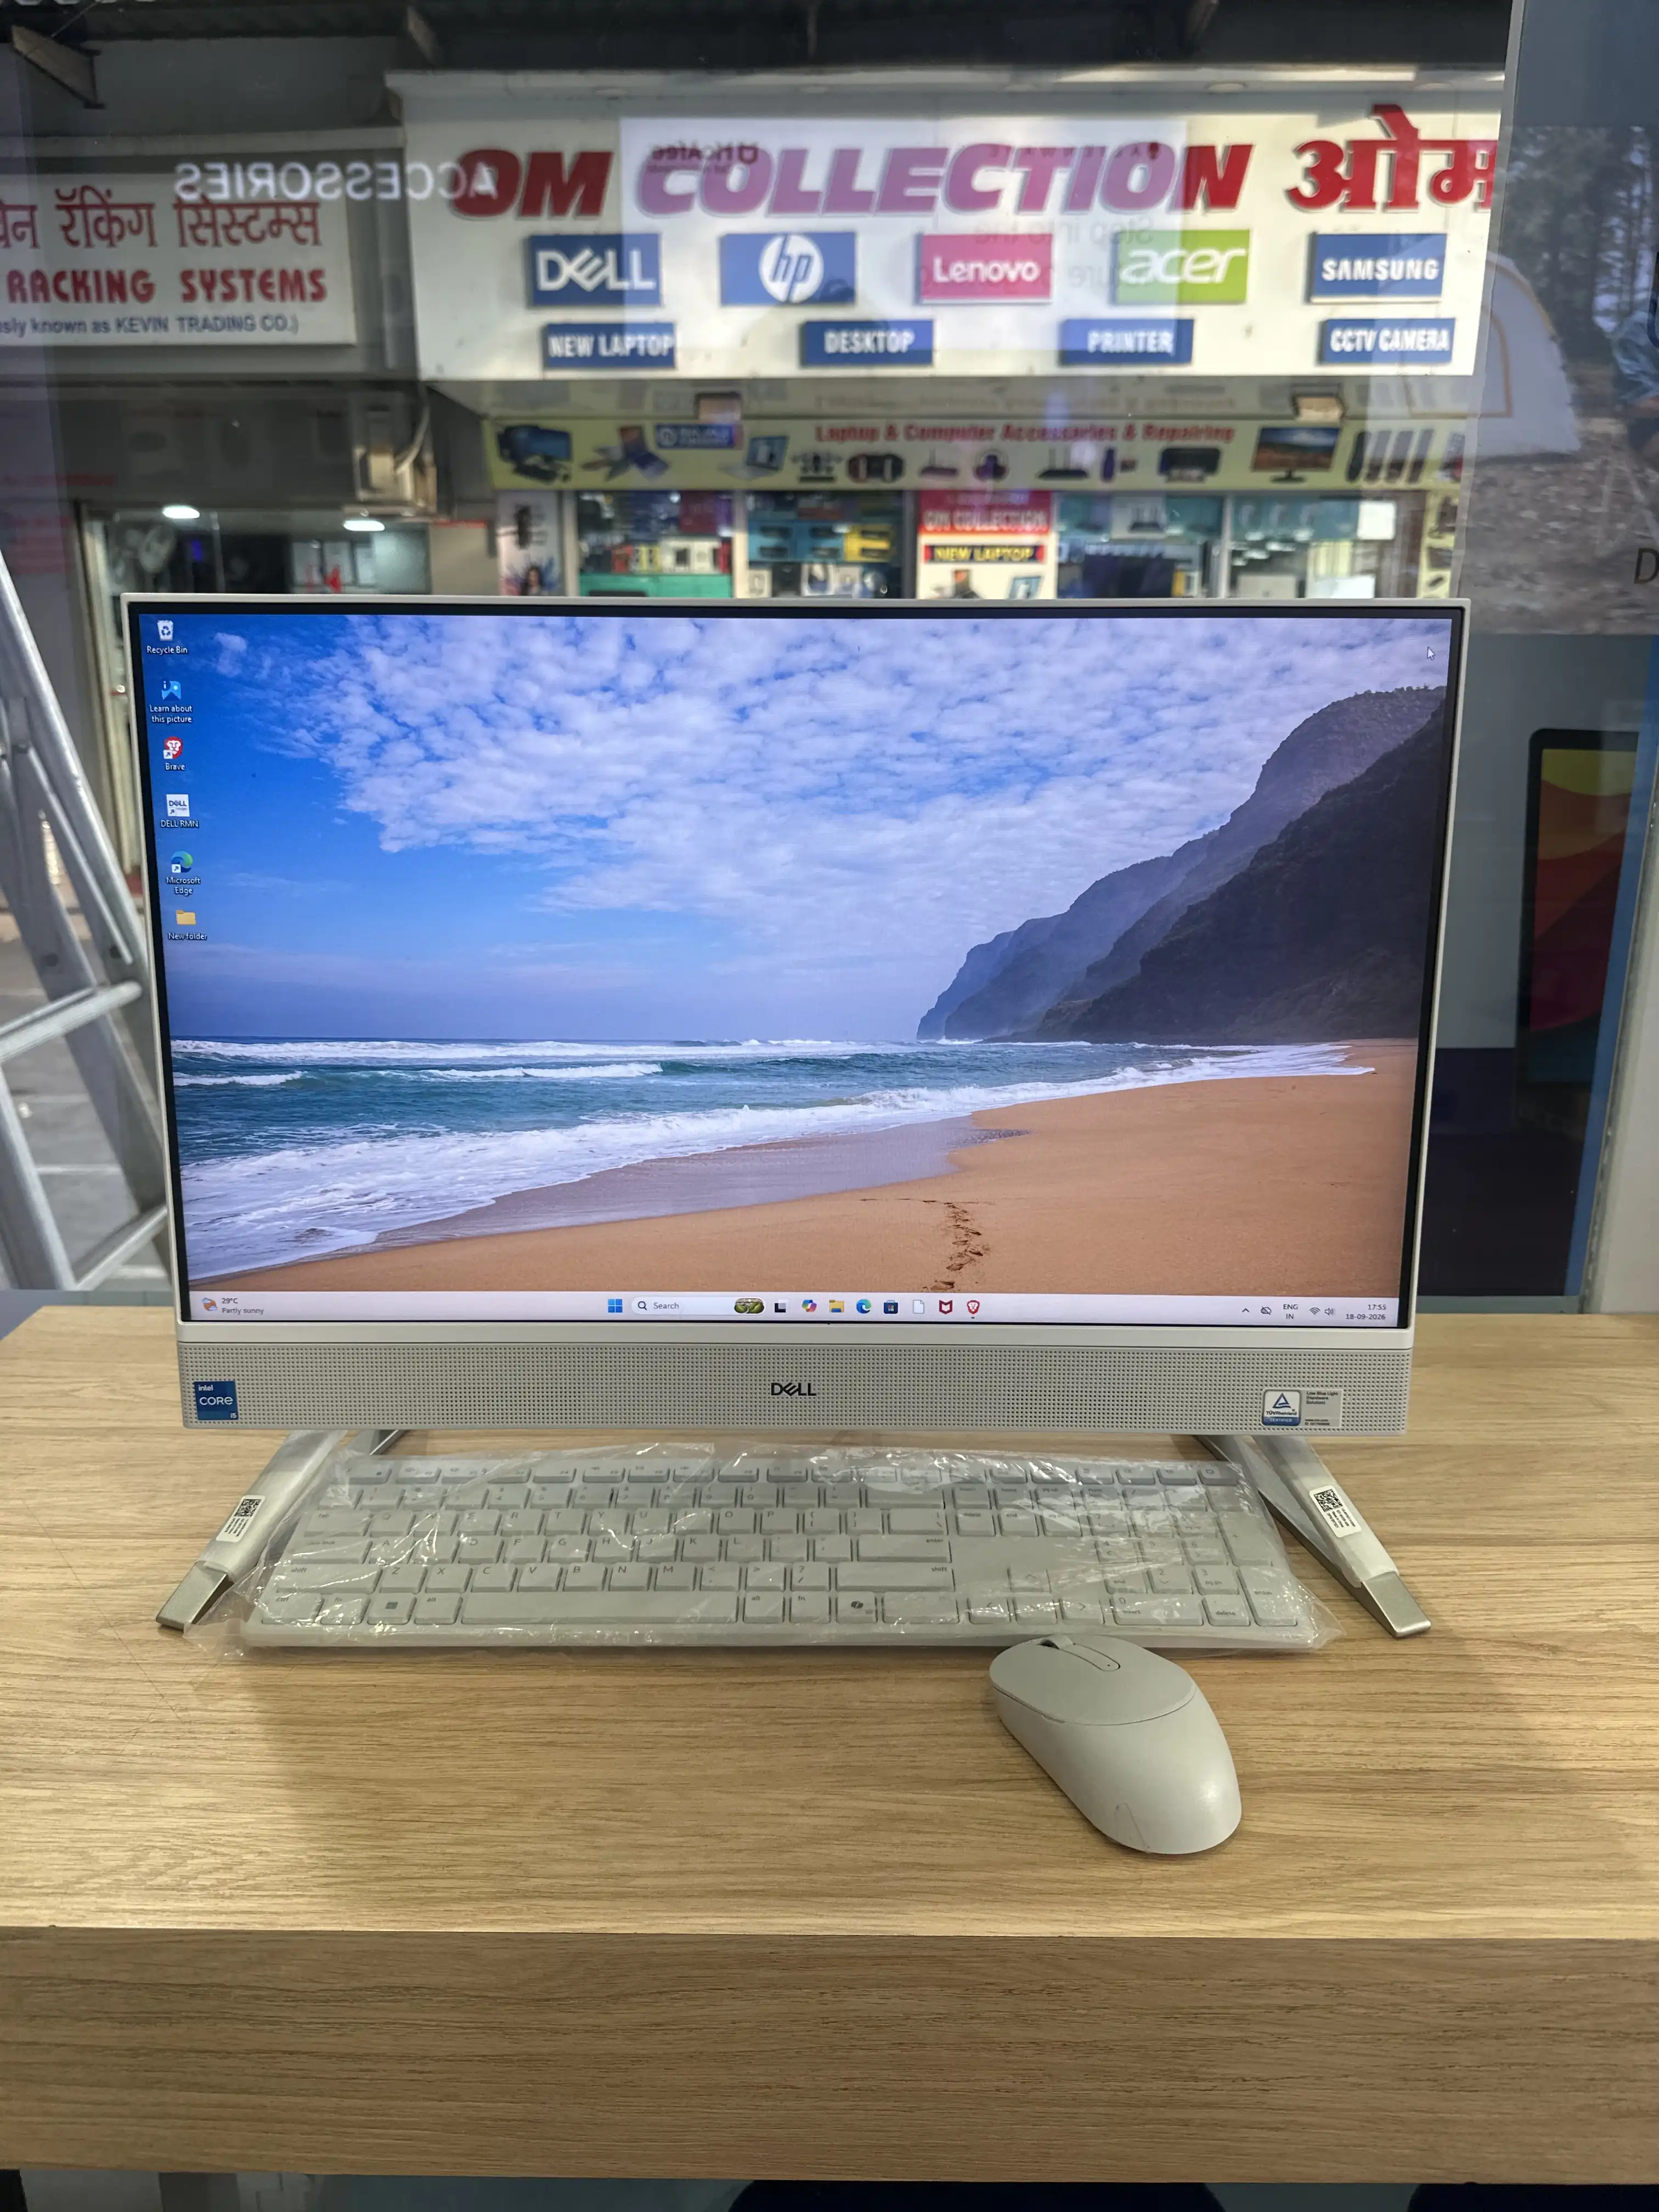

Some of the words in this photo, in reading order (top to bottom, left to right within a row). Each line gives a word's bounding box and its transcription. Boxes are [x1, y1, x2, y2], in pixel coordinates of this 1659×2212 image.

[452, 147, 613, 218] OM
[636, 141, 1254, 217] COLLECTION
[535, 249, 657, 292] DELL
[761, 235, 822, 303] hp
[934, 257, 1041, 284] Lenovo
[1120, 247, 1247, 285] acer
[1322, 258, 1440, 281] SAMSUNG
[7, 269, 156, 303] RACKING
[180, 269, 328, 303] SYSTEMS
[30, 317, 87, 332] known
[92, 320, 111, 332] as
[115, 316, 169, 332] KEVIN
[178, 315, 257, 332] TRADING
[549, 334, 593, 358] NEW
[599, 333, 674, 357] LAPTOP
[825, 331, 915, 354] DESKTOP
[1087, 331, 1174, 356] PRINTER
[1330, 329, 1375, 352] CCTV
[1379, 329, 1450, 352] CAMERA
[904, 425, 995, 443] Computer
[1003, 424, 1117, 441] Accessories
[934, 546, 971, 561] NEW
[146, 645, 174, 656] Recycle
[176, 646, 188, 654] Bin
[149, 704, 170, 713] Learn
[171, 704, 193, 713] about
[167, 715, 193, 724] picture
[165, 762, 186, 770] Brave
[166, 876, 201, 884] Microsoft
[174, 886, 193, 896] Edge
[168, 932, 184, 940] New
[185, 932, 207, 940] folder
[771, 1382, 817, 1396] DELL
